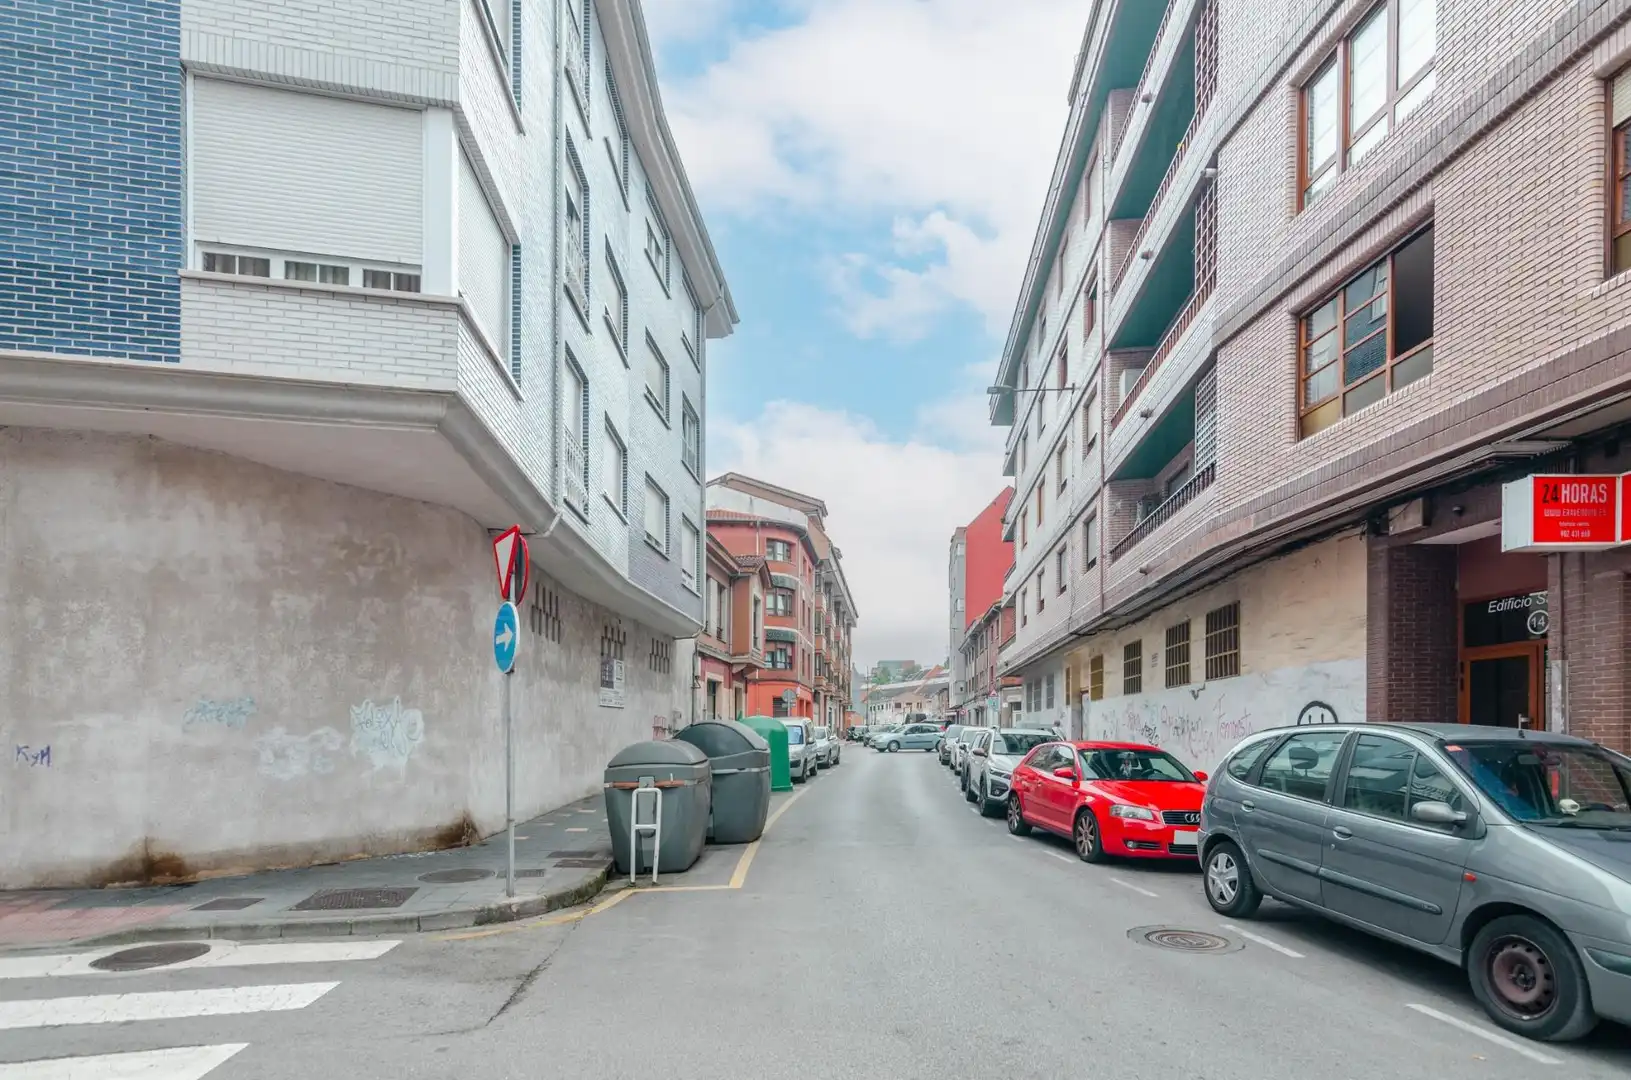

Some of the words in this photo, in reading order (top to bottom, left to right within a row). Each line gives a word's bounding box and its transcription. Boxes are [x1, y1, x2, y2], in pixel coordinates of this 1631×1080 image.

[1542, 483, 1559, 504] 24
[1561, 483, 1607, 504] HORAS
[1487, 596, 1533, 613] Edificio
[1536, 593, 1549, 605] S
[1530, 615, 1546, 628] 14
